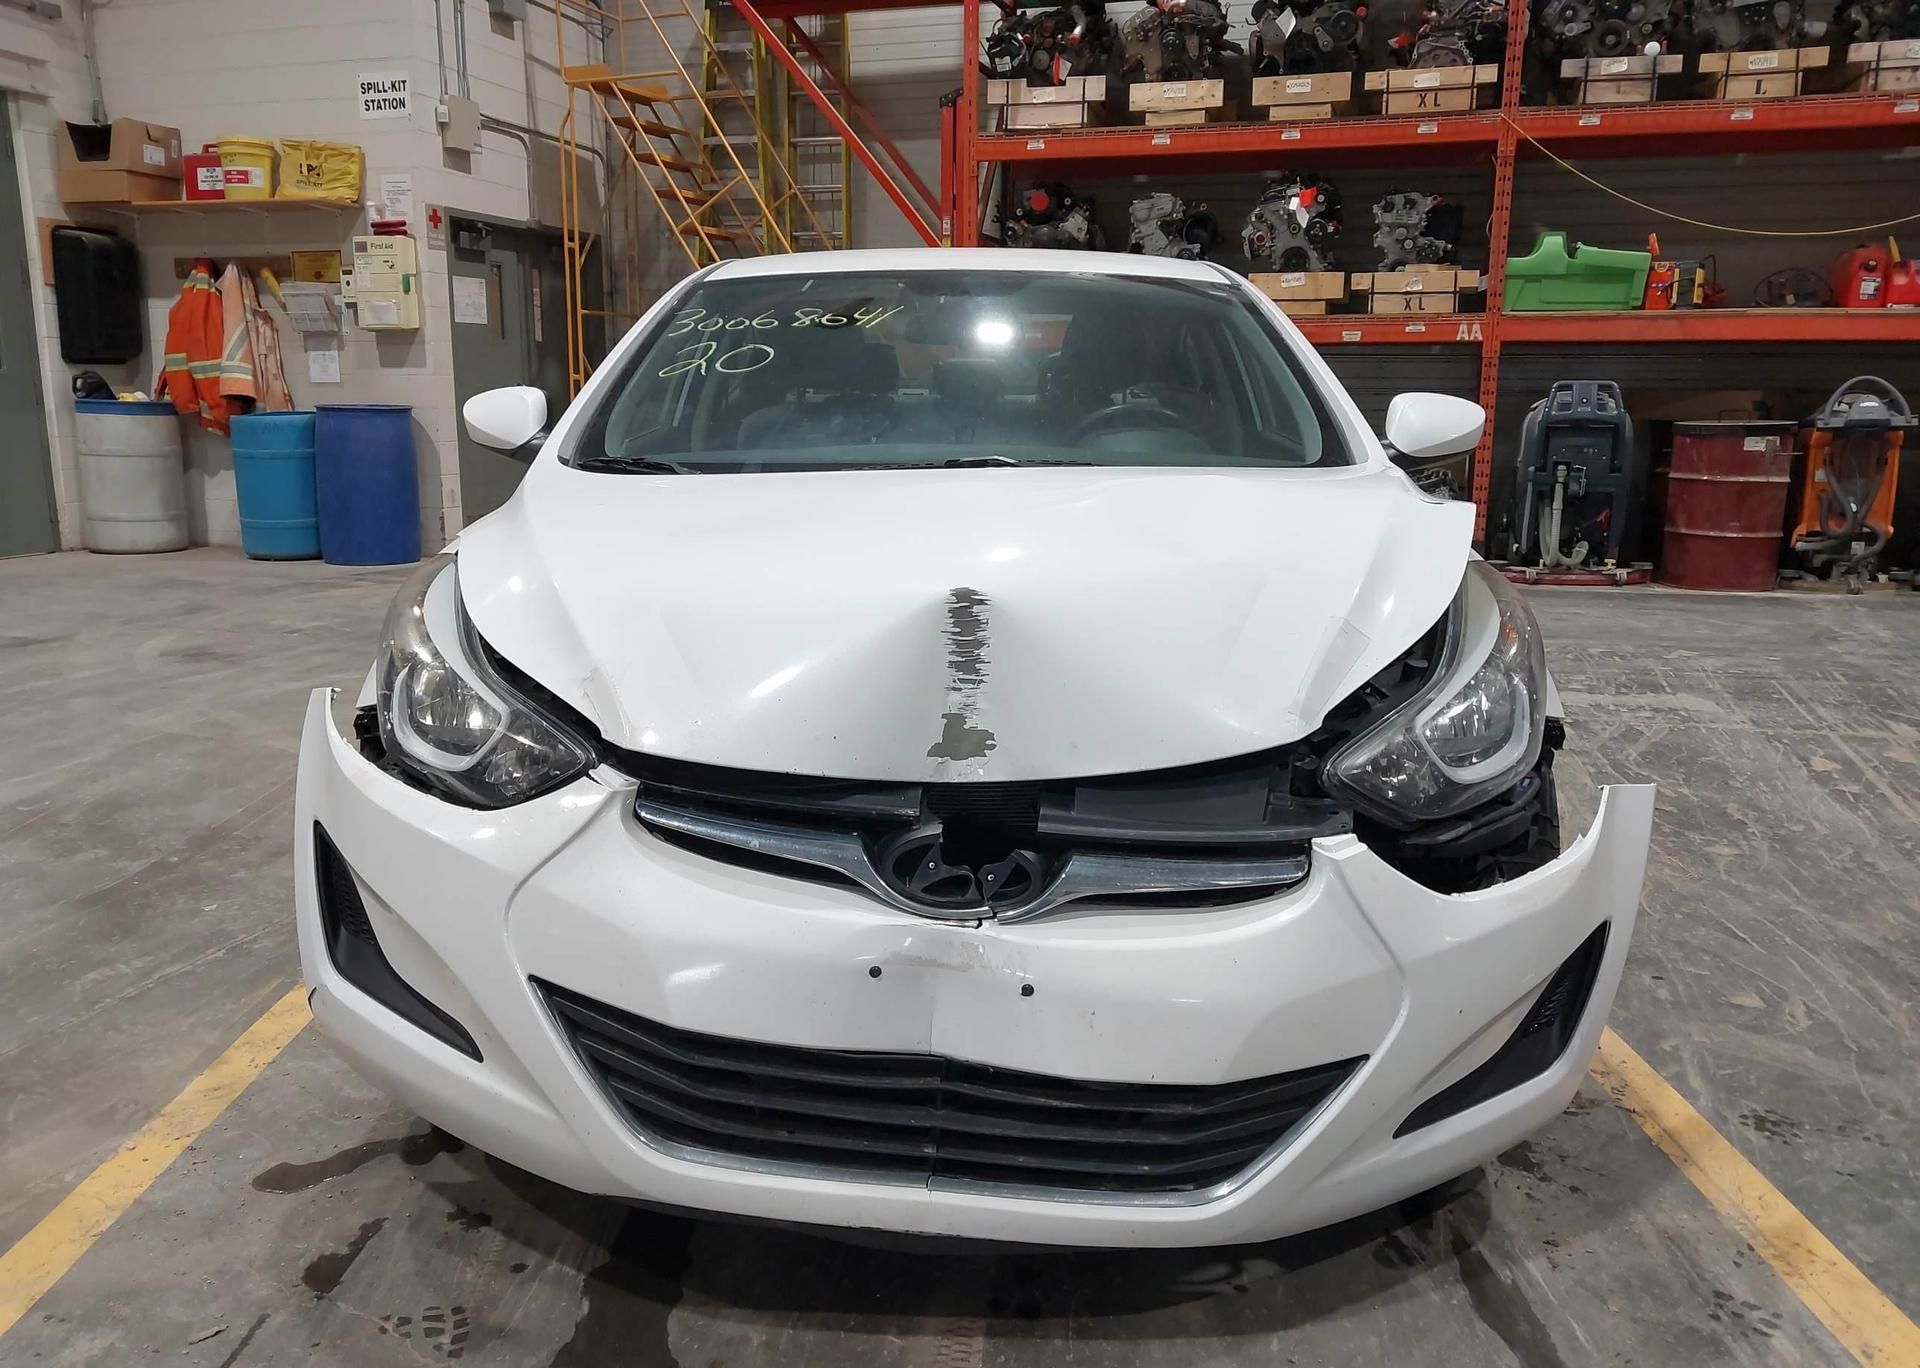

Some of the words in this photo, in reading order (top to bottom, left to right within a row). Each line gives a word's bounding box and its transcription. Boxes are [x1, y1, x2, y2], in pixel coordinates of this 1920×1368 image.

[360, 79, 407, 95] SPILL-KIT
[364, 97, 406, 112] STATION
[1456, 322, 1484, 341] AA
[658, 341, 775, 377] 20
